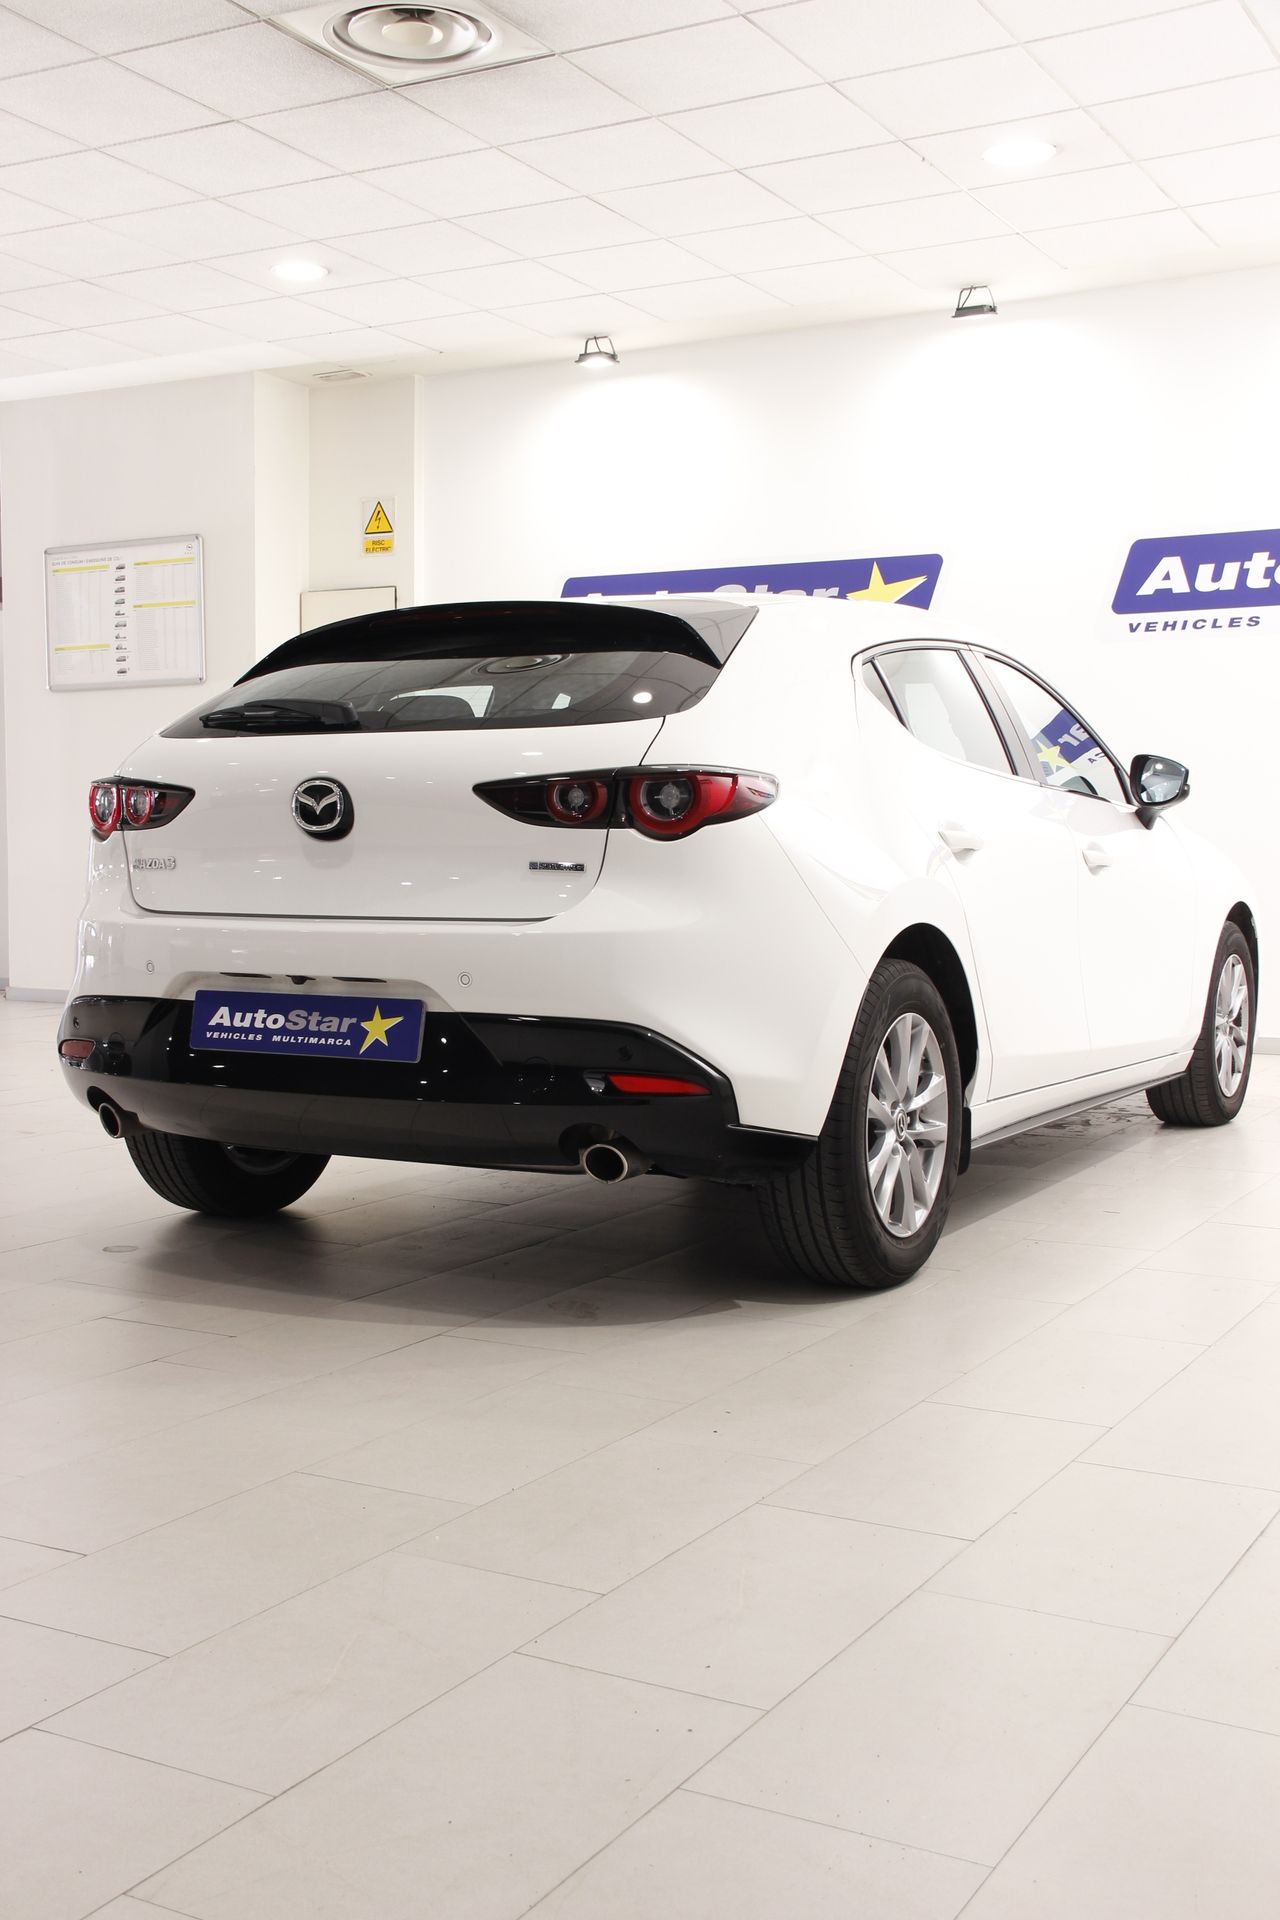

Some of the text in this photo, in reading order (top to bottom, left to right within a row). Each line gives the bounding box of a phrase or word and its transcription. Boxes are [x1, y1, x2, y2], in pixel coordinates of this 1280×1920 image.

[1135, 551, 1280, 596] Aut
[1128, 616, 1261, 633] VEHICLES
[208, 1006, 357, 1033] AutoStar
[206, 1031, 352, 1046] VEHICLES MULTIMARCA
